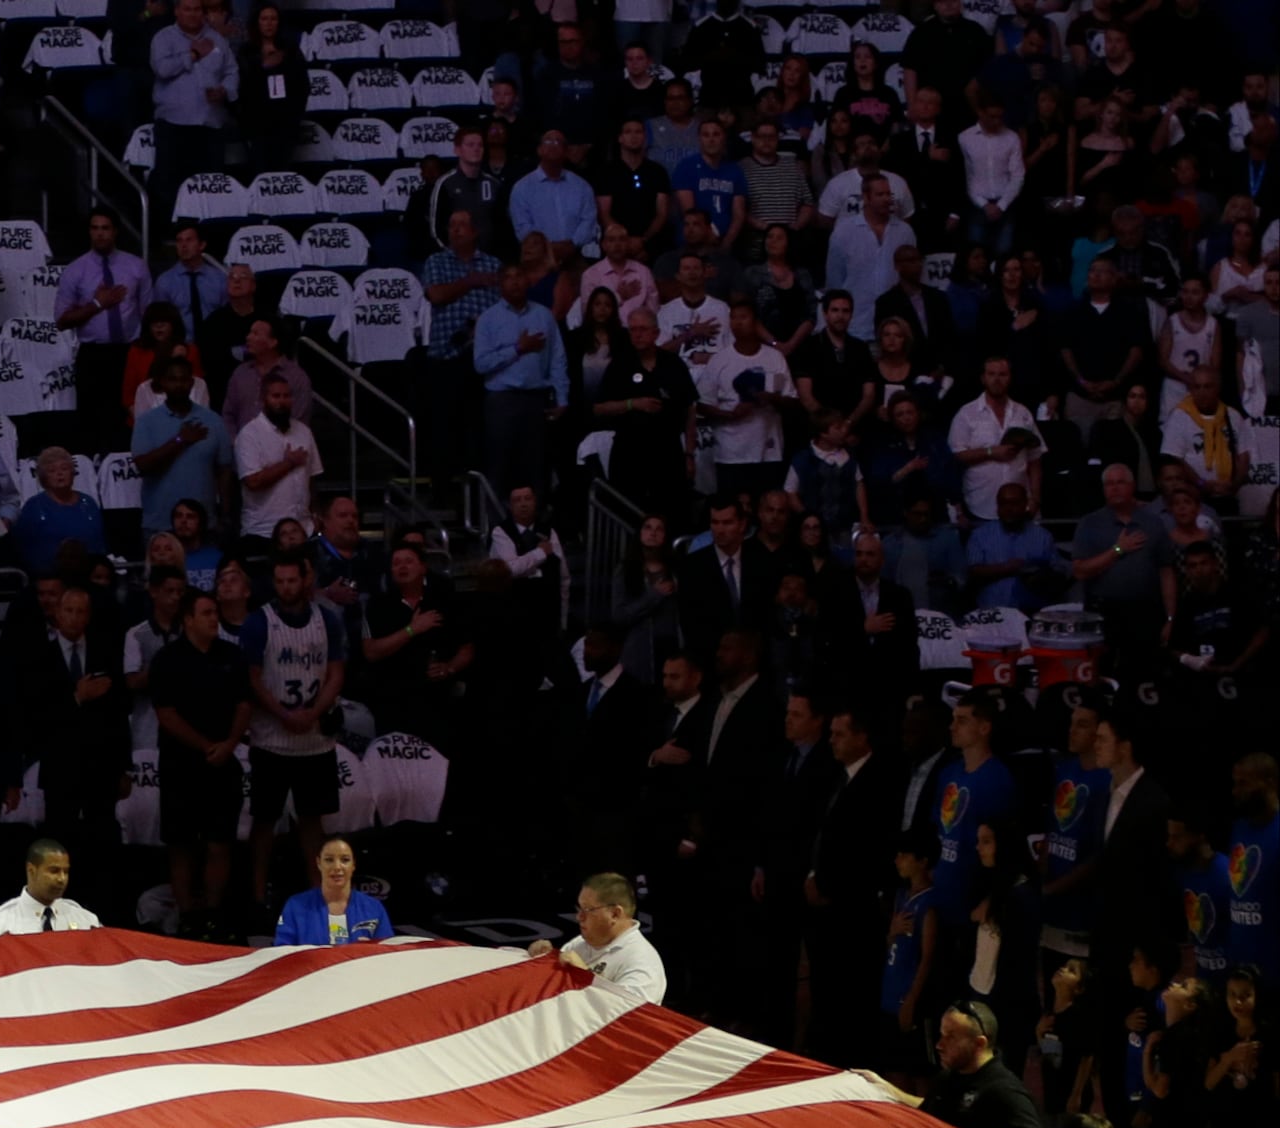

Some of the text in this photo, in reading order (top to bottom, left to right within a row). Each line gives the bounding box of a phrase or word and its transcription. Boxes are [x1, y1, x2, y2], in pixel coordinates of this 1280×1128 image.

[332, 22, 362, 32] PURE
[390, 26, 432, 39] MAGIC
[52, 29, 82, 38] PURE
[325, 31, 365, 46] MAGIC
[40, 36, 83, 48] MAGIC
[357, 76, 399, 87] MAGIC
[422, 74, 464, 84] MAGIC
[308, 85, 331, 96] GIC
[350, 123, 379, 133] PURE
[424, 123, 453, 134] PURE
[412, 132, 455, 143] MAGIC
[201, 174, 230, 183] PURE
[271, 174, 300, 185] PURE
[337, 175, 367, 185] PURE
[187, 182, 232, 194] MAGIC
[260, 183, 303, 196] MAGIC
[325, 184, 368, 195] MAGIC
[1, 228, 32, 238] PURE
[320, 229, 349, 239] PURE
[253, 234, 283, 245] PURE
[308, 237, 351, 248] MAGIC
[240, 244, 285, 255] MAGIC
[307, 276, 337, 287] PURE
[379, 279, 408, 289] PURE
[294, 286, 339, 297] MAGIC
[366, 288, 410, 299] MAGIC
[369, 304, 400, 314] PURE
[356, 313, 401, 325] MAGIC
[11, 328, 57, 345] MAGIC
[59, 365, 76, 378] PU
[992, 664, 1012, 685] G
[1077, 662, 1094, 682] G
[1139, 682, 1160, 705] G
[1217, 676, 1238, 700] G
[1063, 687, 1083, 708] G
[378, 747, 431, 760] MAGIC
[142, 762, 160, 773] PU
